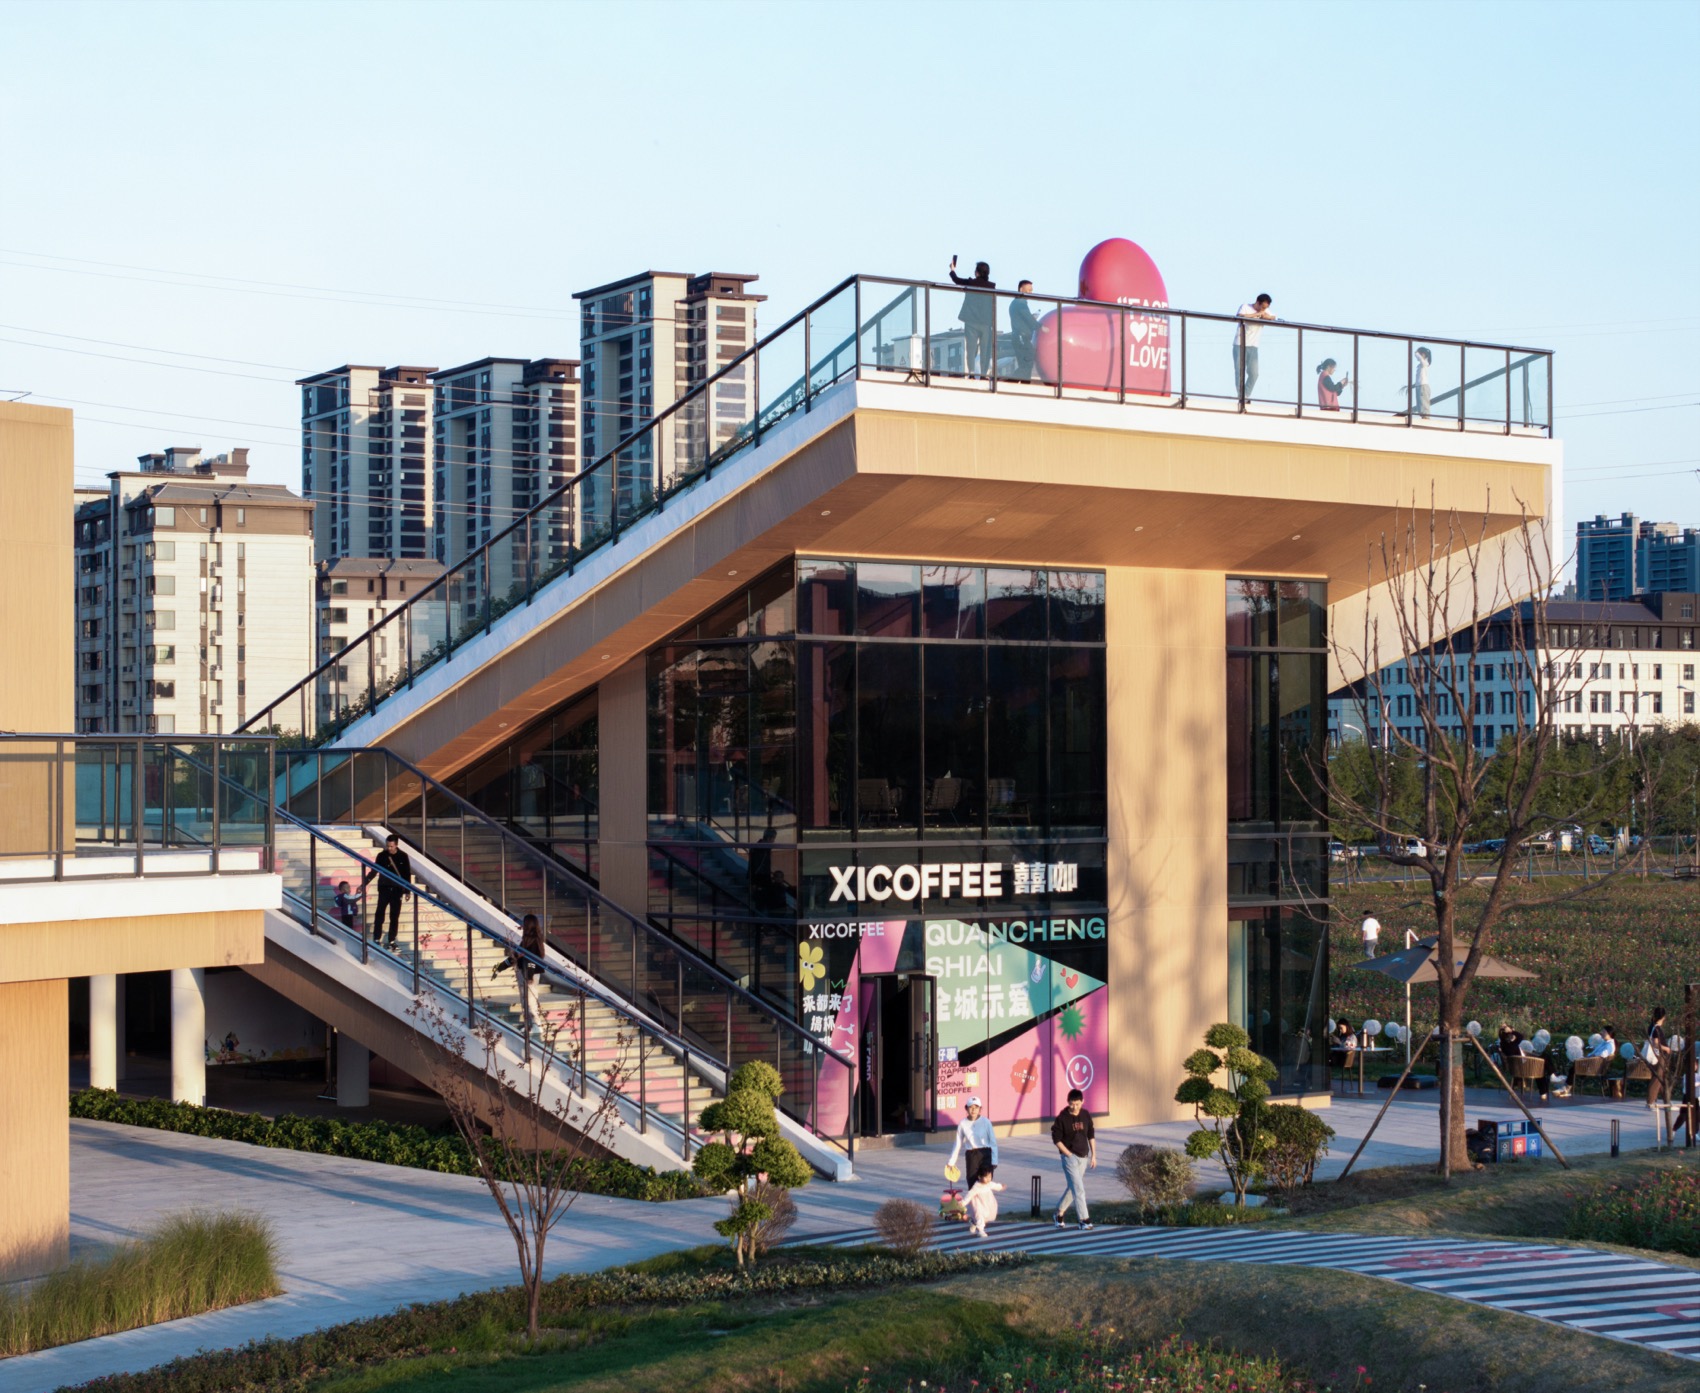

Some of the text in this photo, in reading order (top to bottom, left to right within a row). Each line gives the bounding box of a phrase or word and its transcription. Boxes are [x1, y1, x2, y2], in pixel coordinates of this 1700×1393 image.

[1129, 344, 1168, 370] LOVE
[829, 863, 1002, 901] XICOFFEE
[809, 921, 885, 939] XICOFFEE
[925, 917, 1106, 947] QUANCHENG
[925, 954, 1002, 979] SHIAI
[802, 993, 853, 1014] 来都来了
[941, 1066, 977, 1075] HAPPENS
[941, 1080, 964, 1089] DRINK
